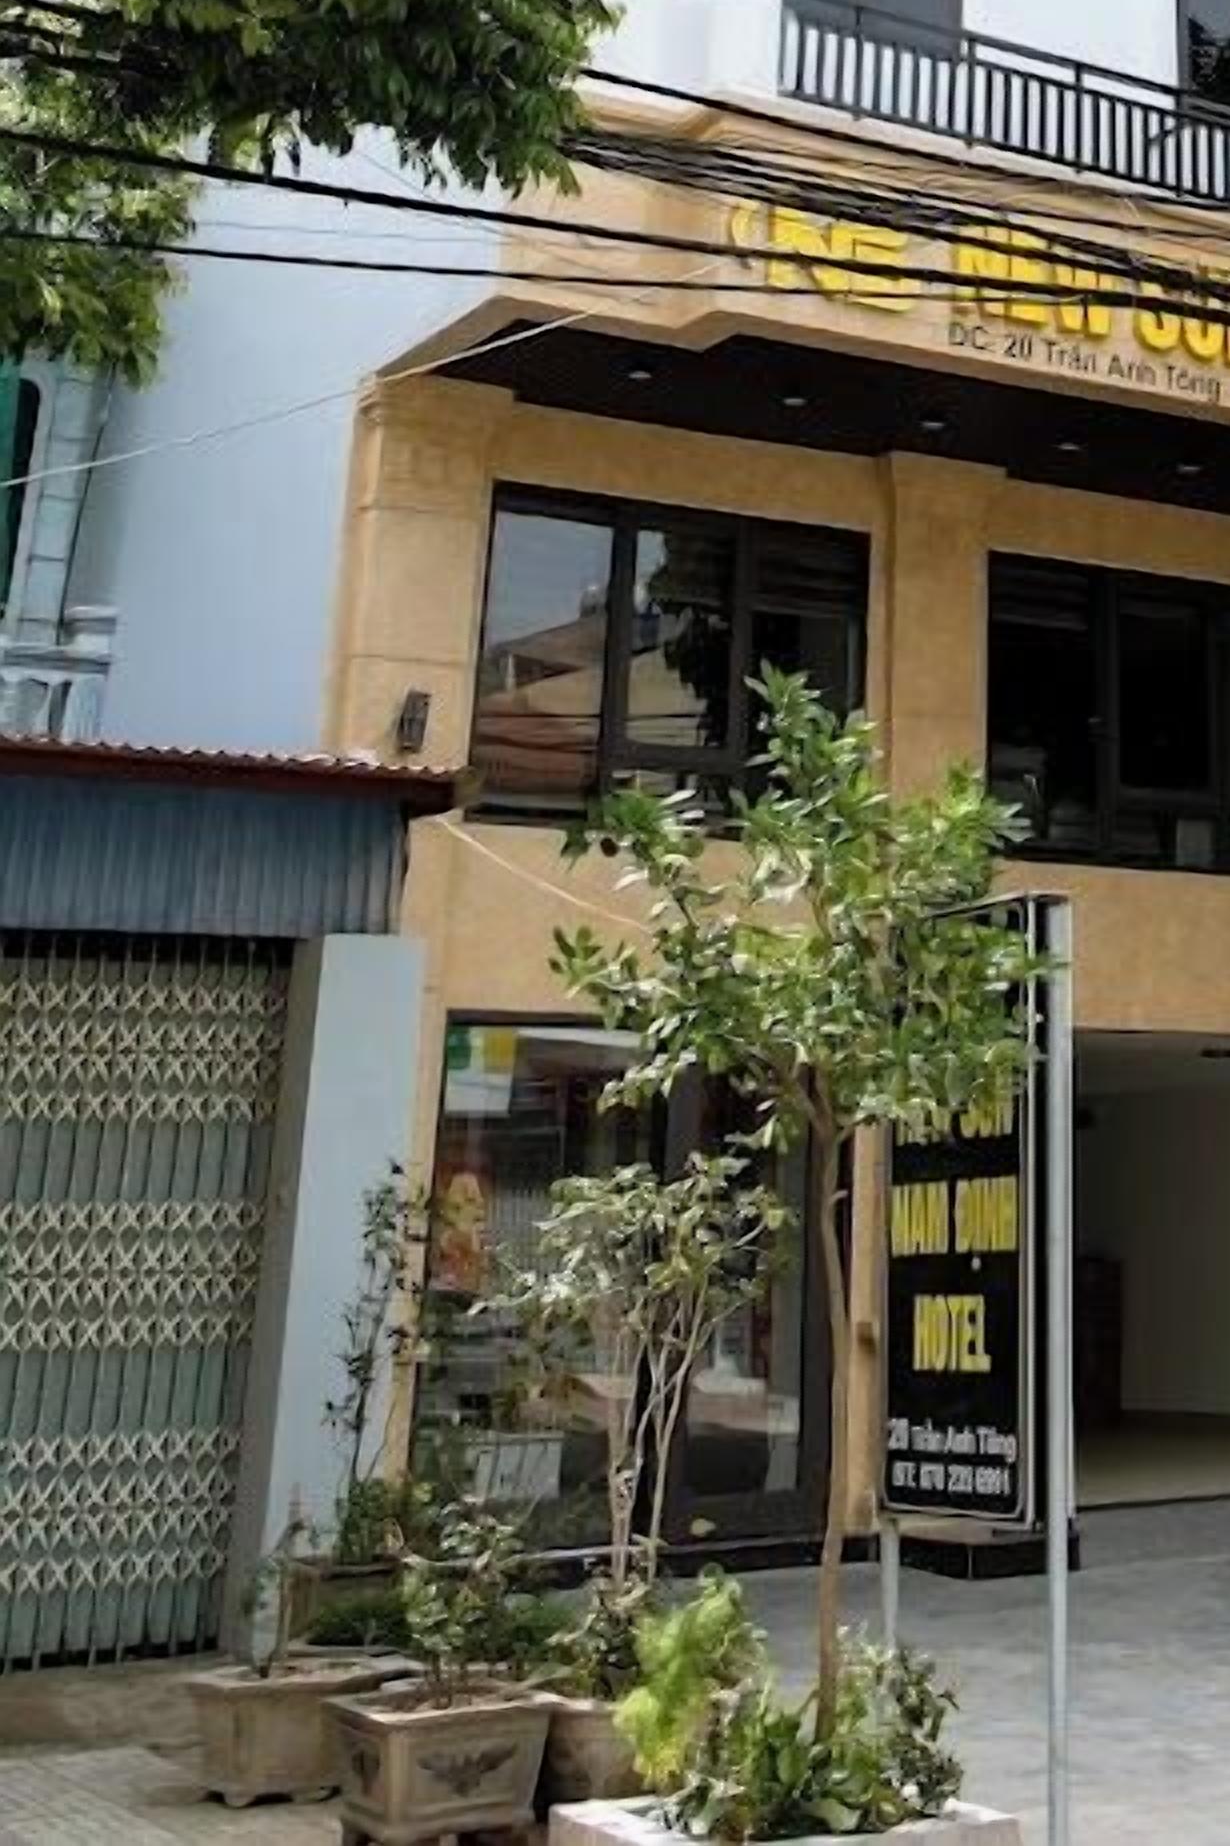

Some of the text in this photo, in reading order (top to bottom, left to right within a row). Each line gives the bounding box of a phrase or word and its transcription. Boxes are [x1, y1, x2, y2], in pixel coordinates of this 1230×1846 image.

[952, 224, 1120, 337] NEW
[1107, 354, 1157, 386] Anh
[913, 1294, 991, 1372] HOTEL
